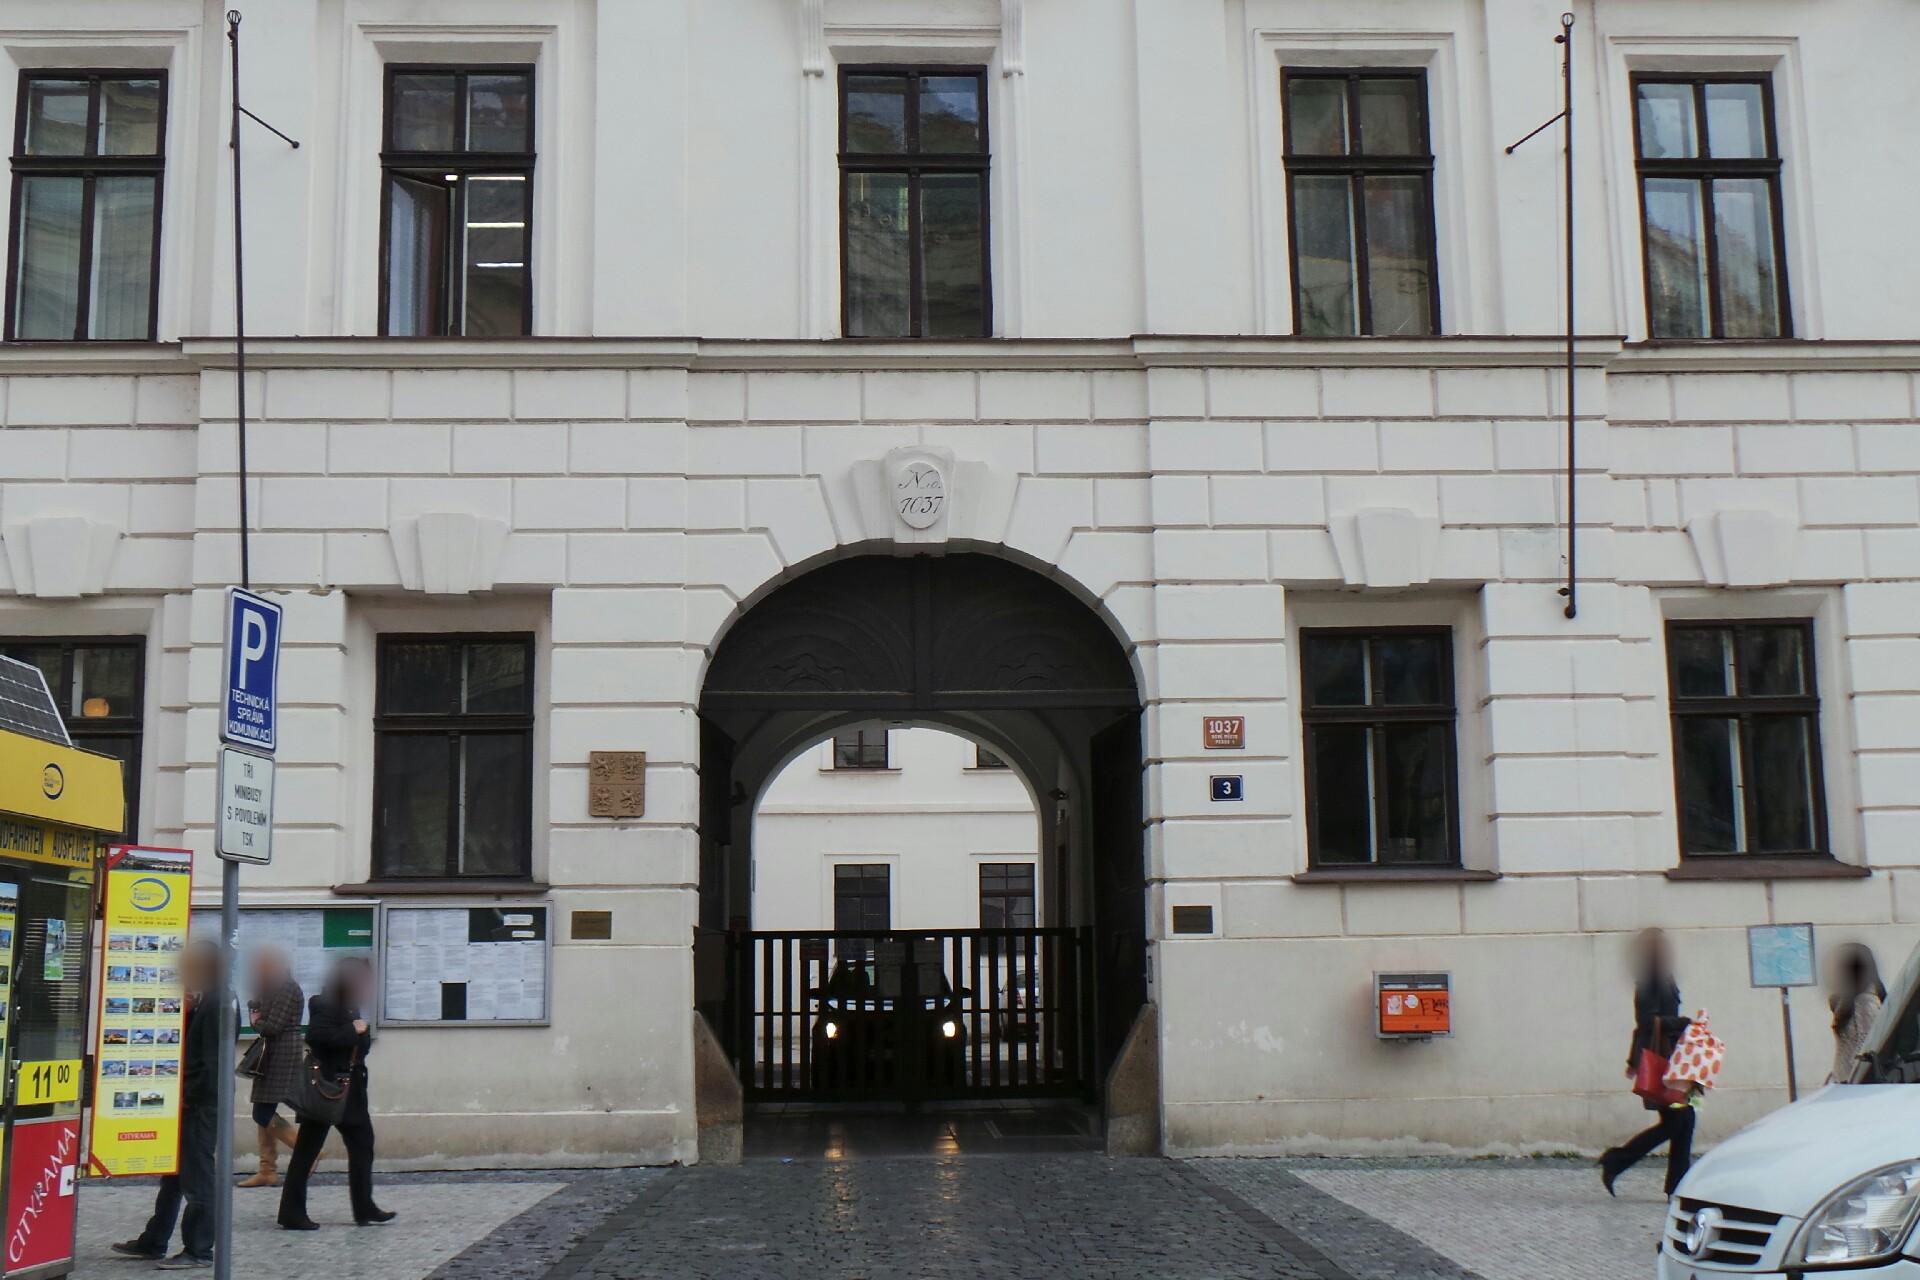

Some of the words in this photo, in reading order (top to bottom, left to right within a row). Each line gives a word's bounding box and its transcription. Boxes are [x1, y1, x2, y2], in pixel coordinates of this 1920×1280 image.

[900, 496, 944, 514] 1037
[238, 608, 267, 690] P
[232, 689, 271, 711] TECHNICKÁ
[237, 706, 264, 725] SPRÁVA
[228, 720, 271, 742] KOMUNIKACÍ
[1209, 720, 1240, 734] 1037
[234, 784, 262, 803] MINIBUSY
[1223, 781, 1232, 795] 3
[226, 805, 233, 821] S
[242, 831, 254, 847] TSK
[8, 1126, 77, 1263] CITYRAMA
